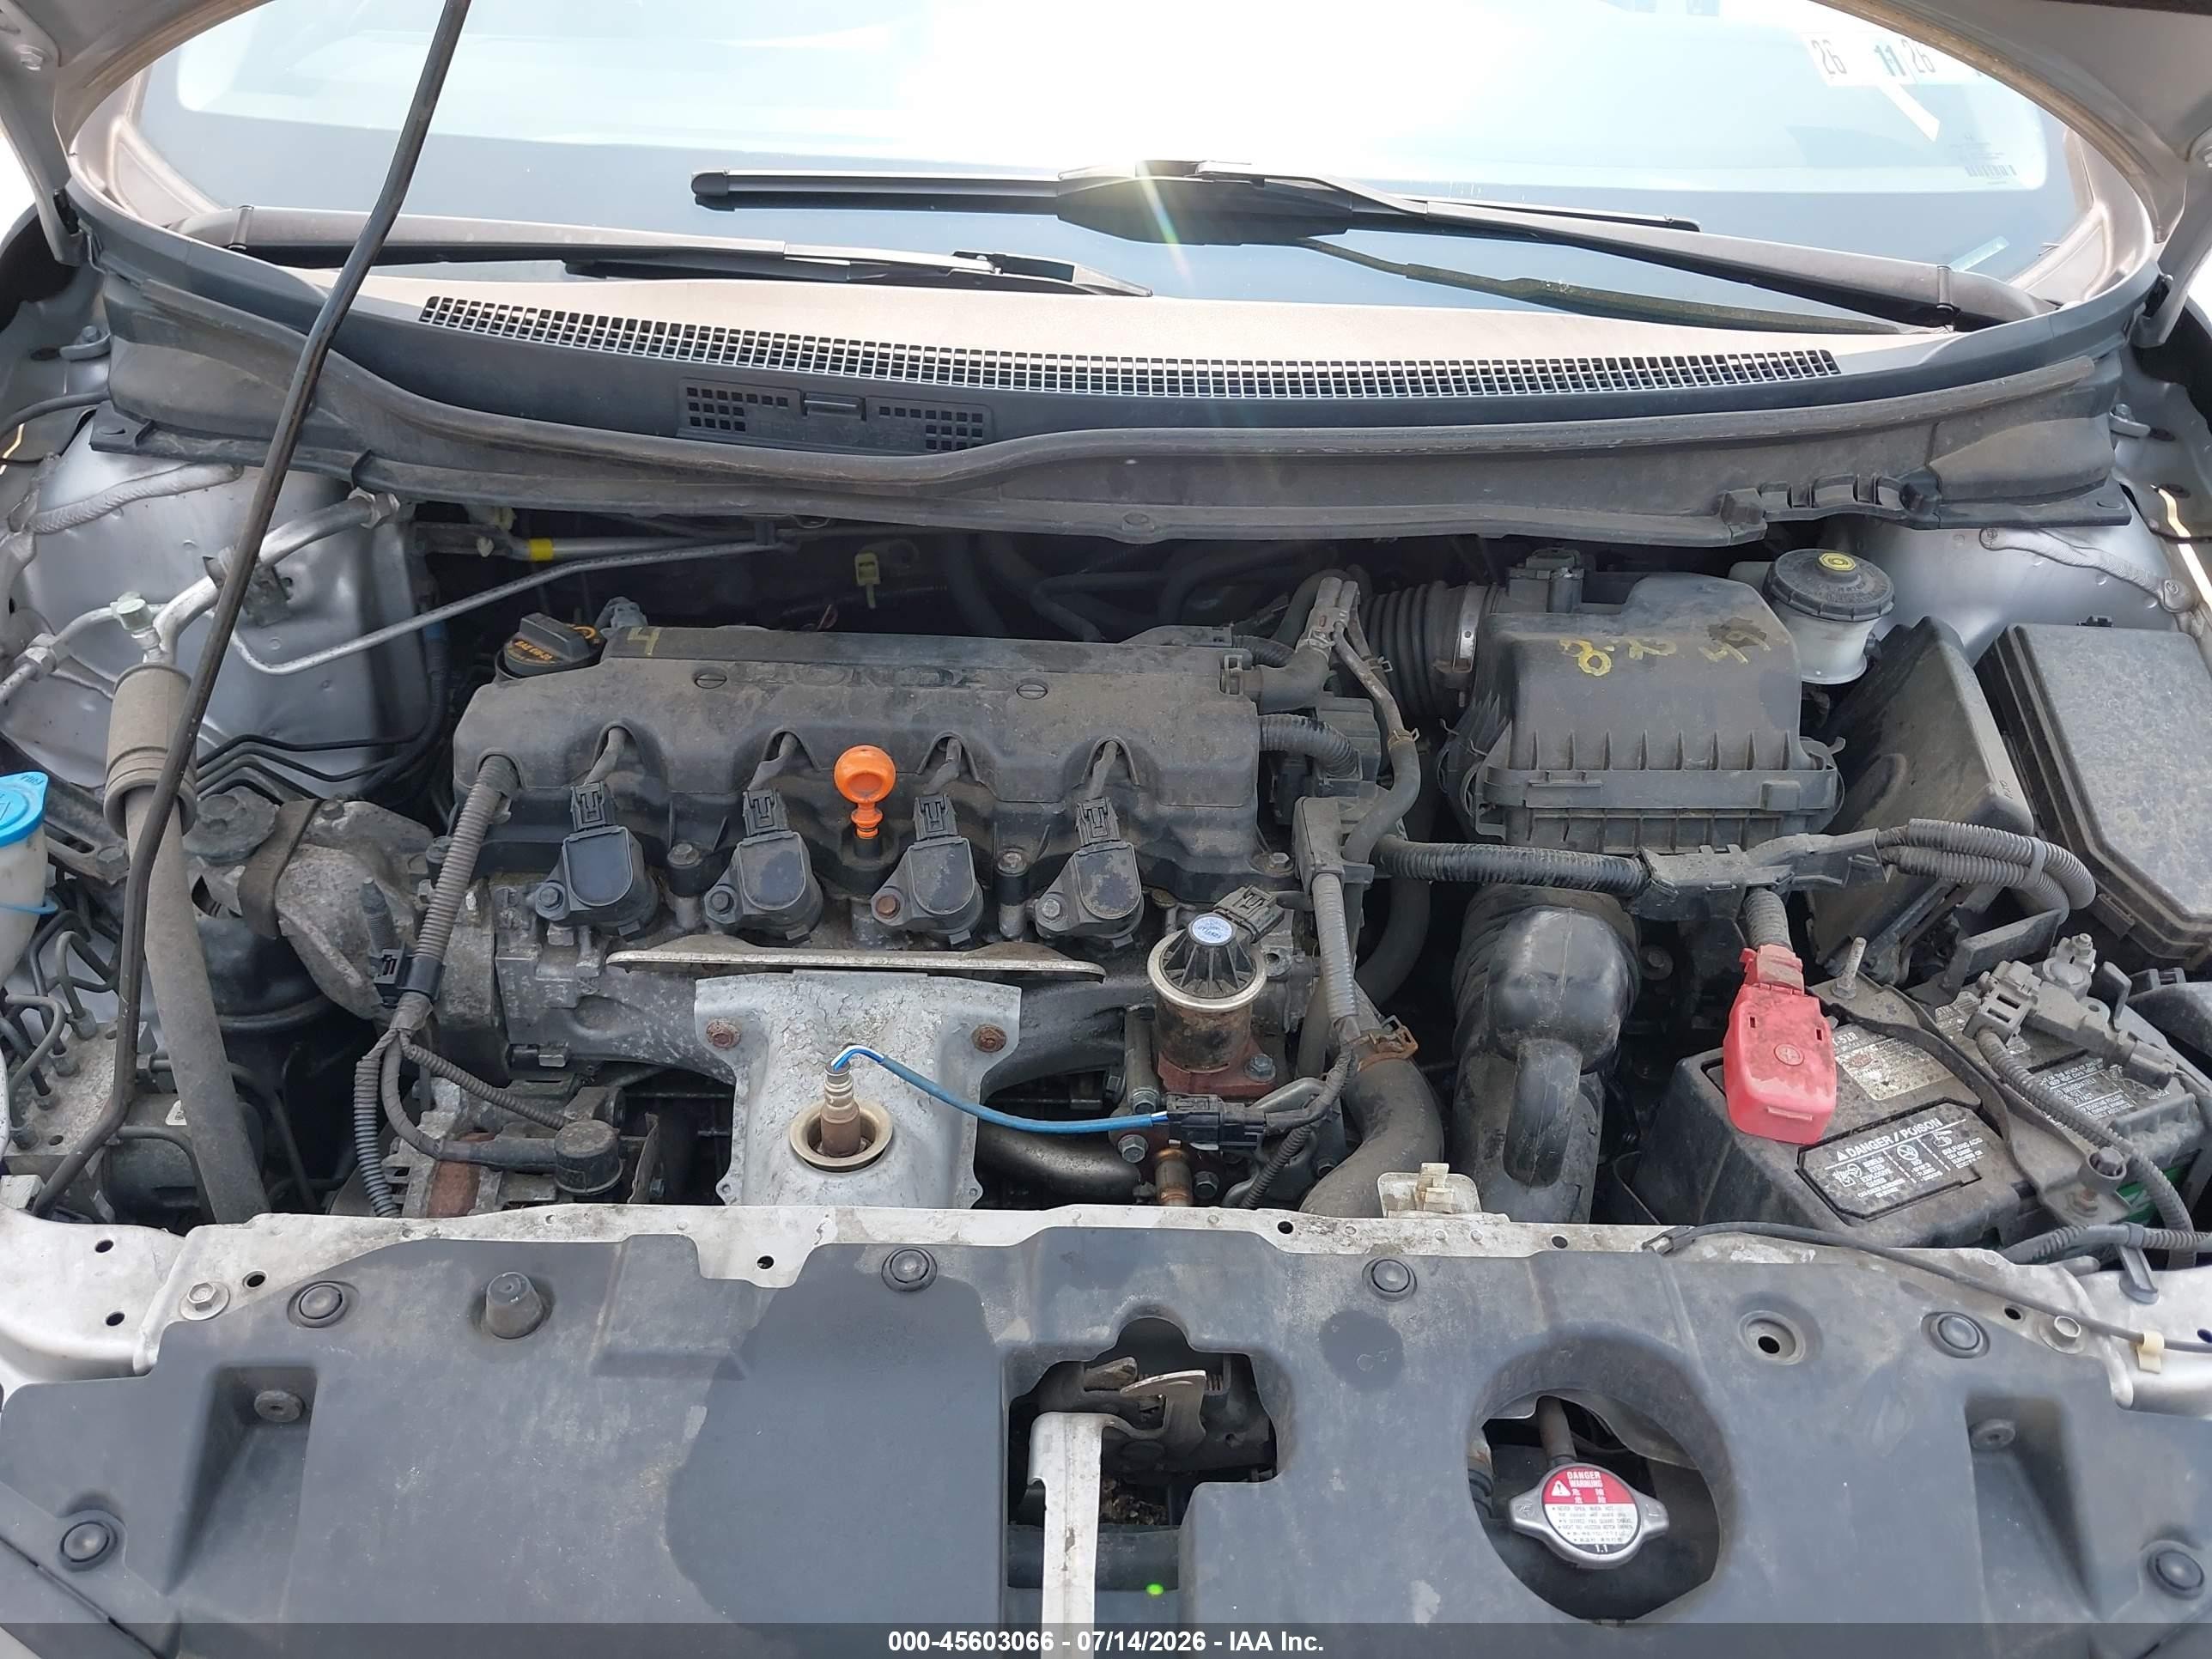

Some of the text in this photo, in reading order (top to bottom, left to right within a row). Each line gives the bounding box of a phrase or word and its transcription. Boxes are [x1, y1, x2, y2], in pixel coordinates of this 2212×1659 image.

[1811, 40, 1848, 76] 26
[1901, 39, 1937, 74] 26
[627, 626, 661, 656] 4
[1845, 1135, 1894, 1158] DANGER
[1899, 1117, 1944, 1139] POISON
[1566, 1471, 1601, 1480] DANGER
[1568, 1479, 1604, 1488] WARNING
[1595, 1544, 1608, 1553] 1.1
